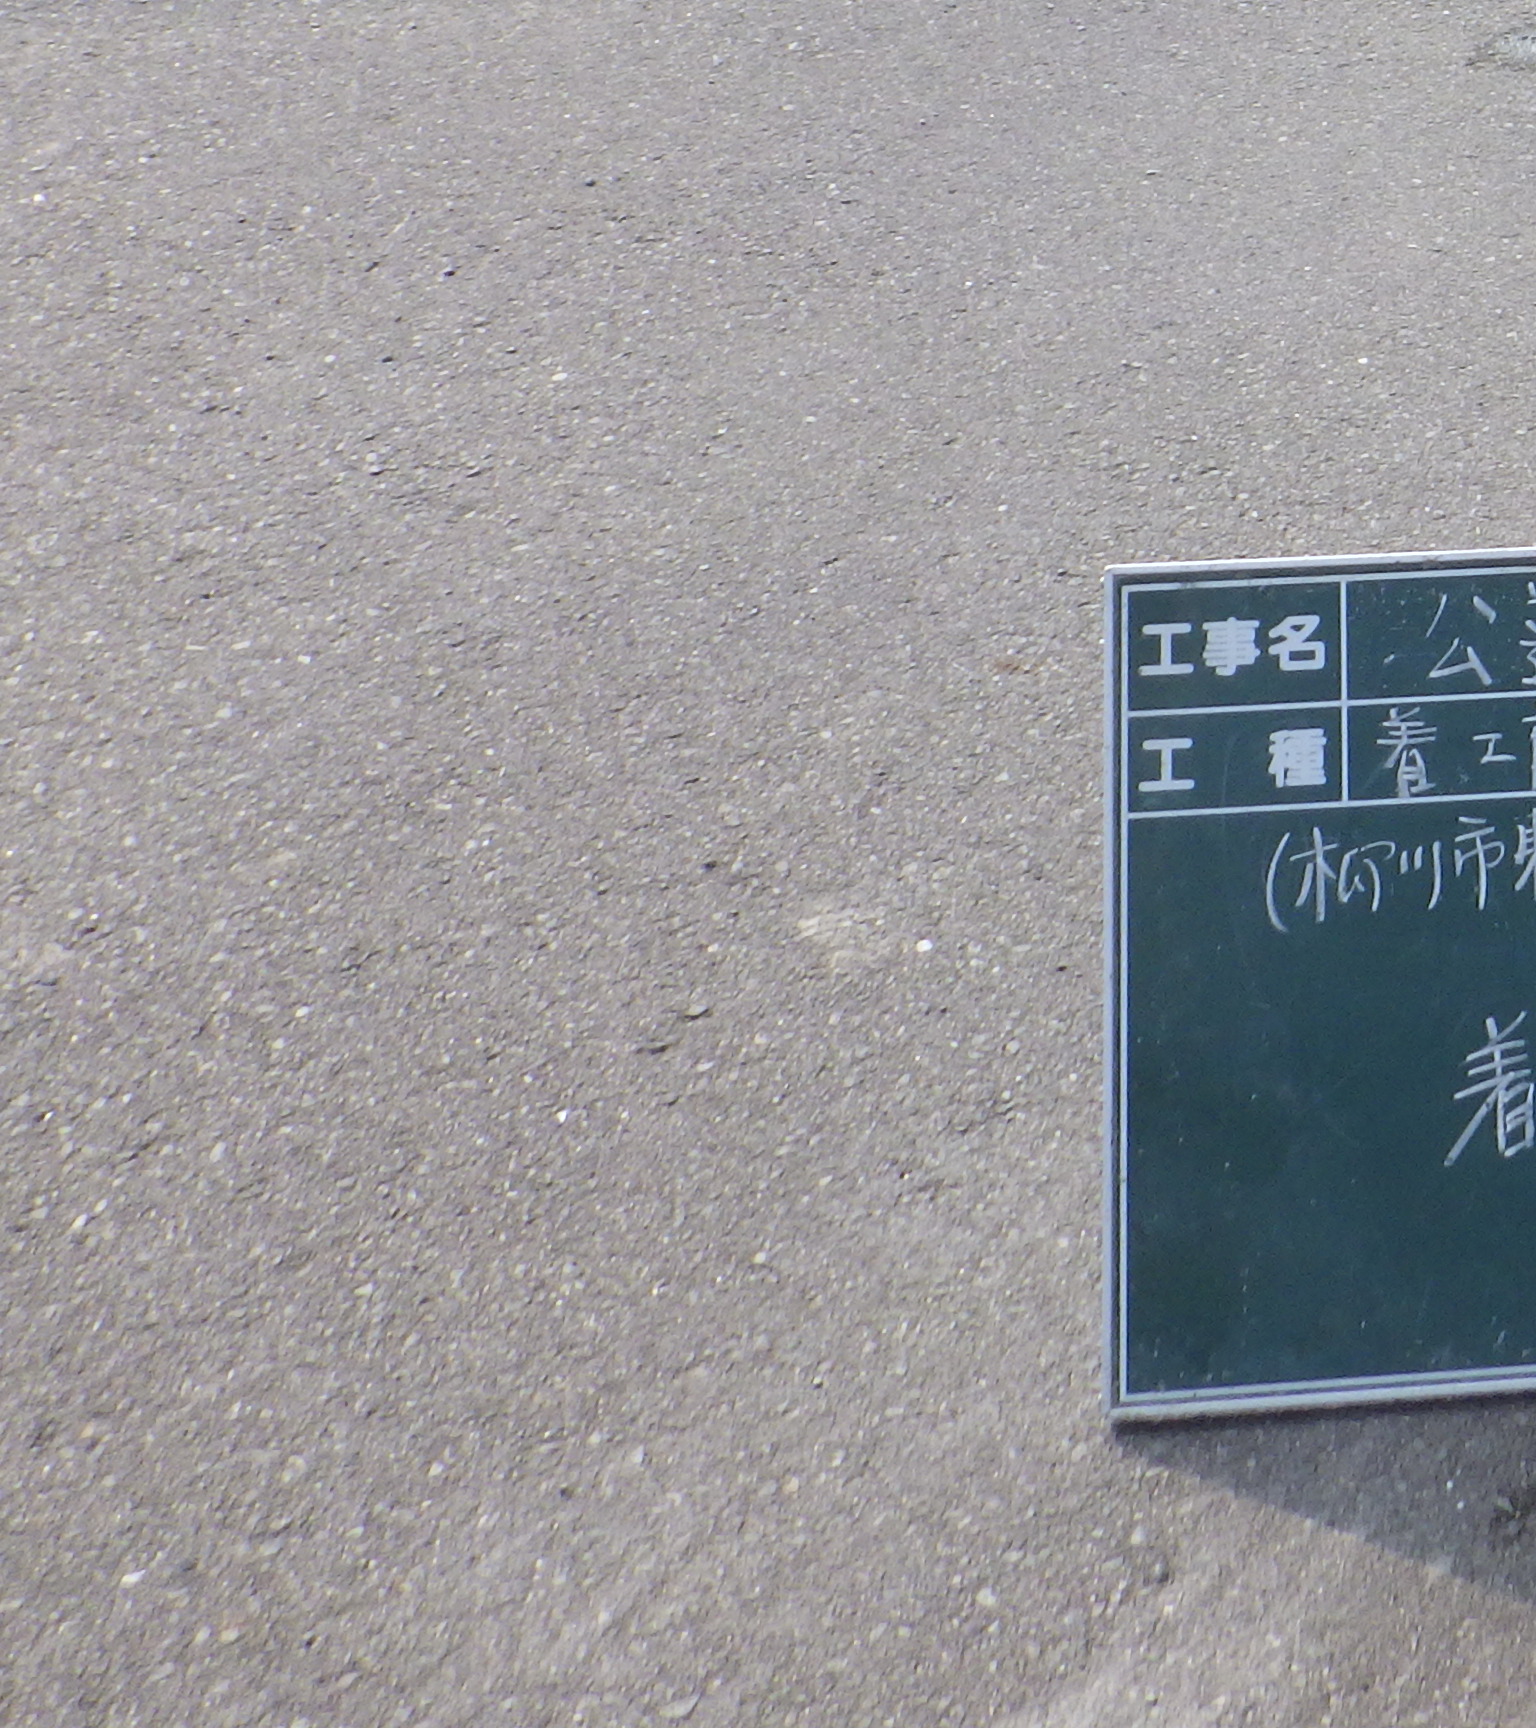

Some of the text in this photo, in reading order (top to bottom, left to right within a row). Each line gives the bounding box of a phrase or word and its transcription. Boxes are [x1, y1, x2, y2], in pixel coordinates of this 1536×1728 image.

[1138, 614, 1326, 677] 工事名
[1138, 727, 1327, 792] 工種
